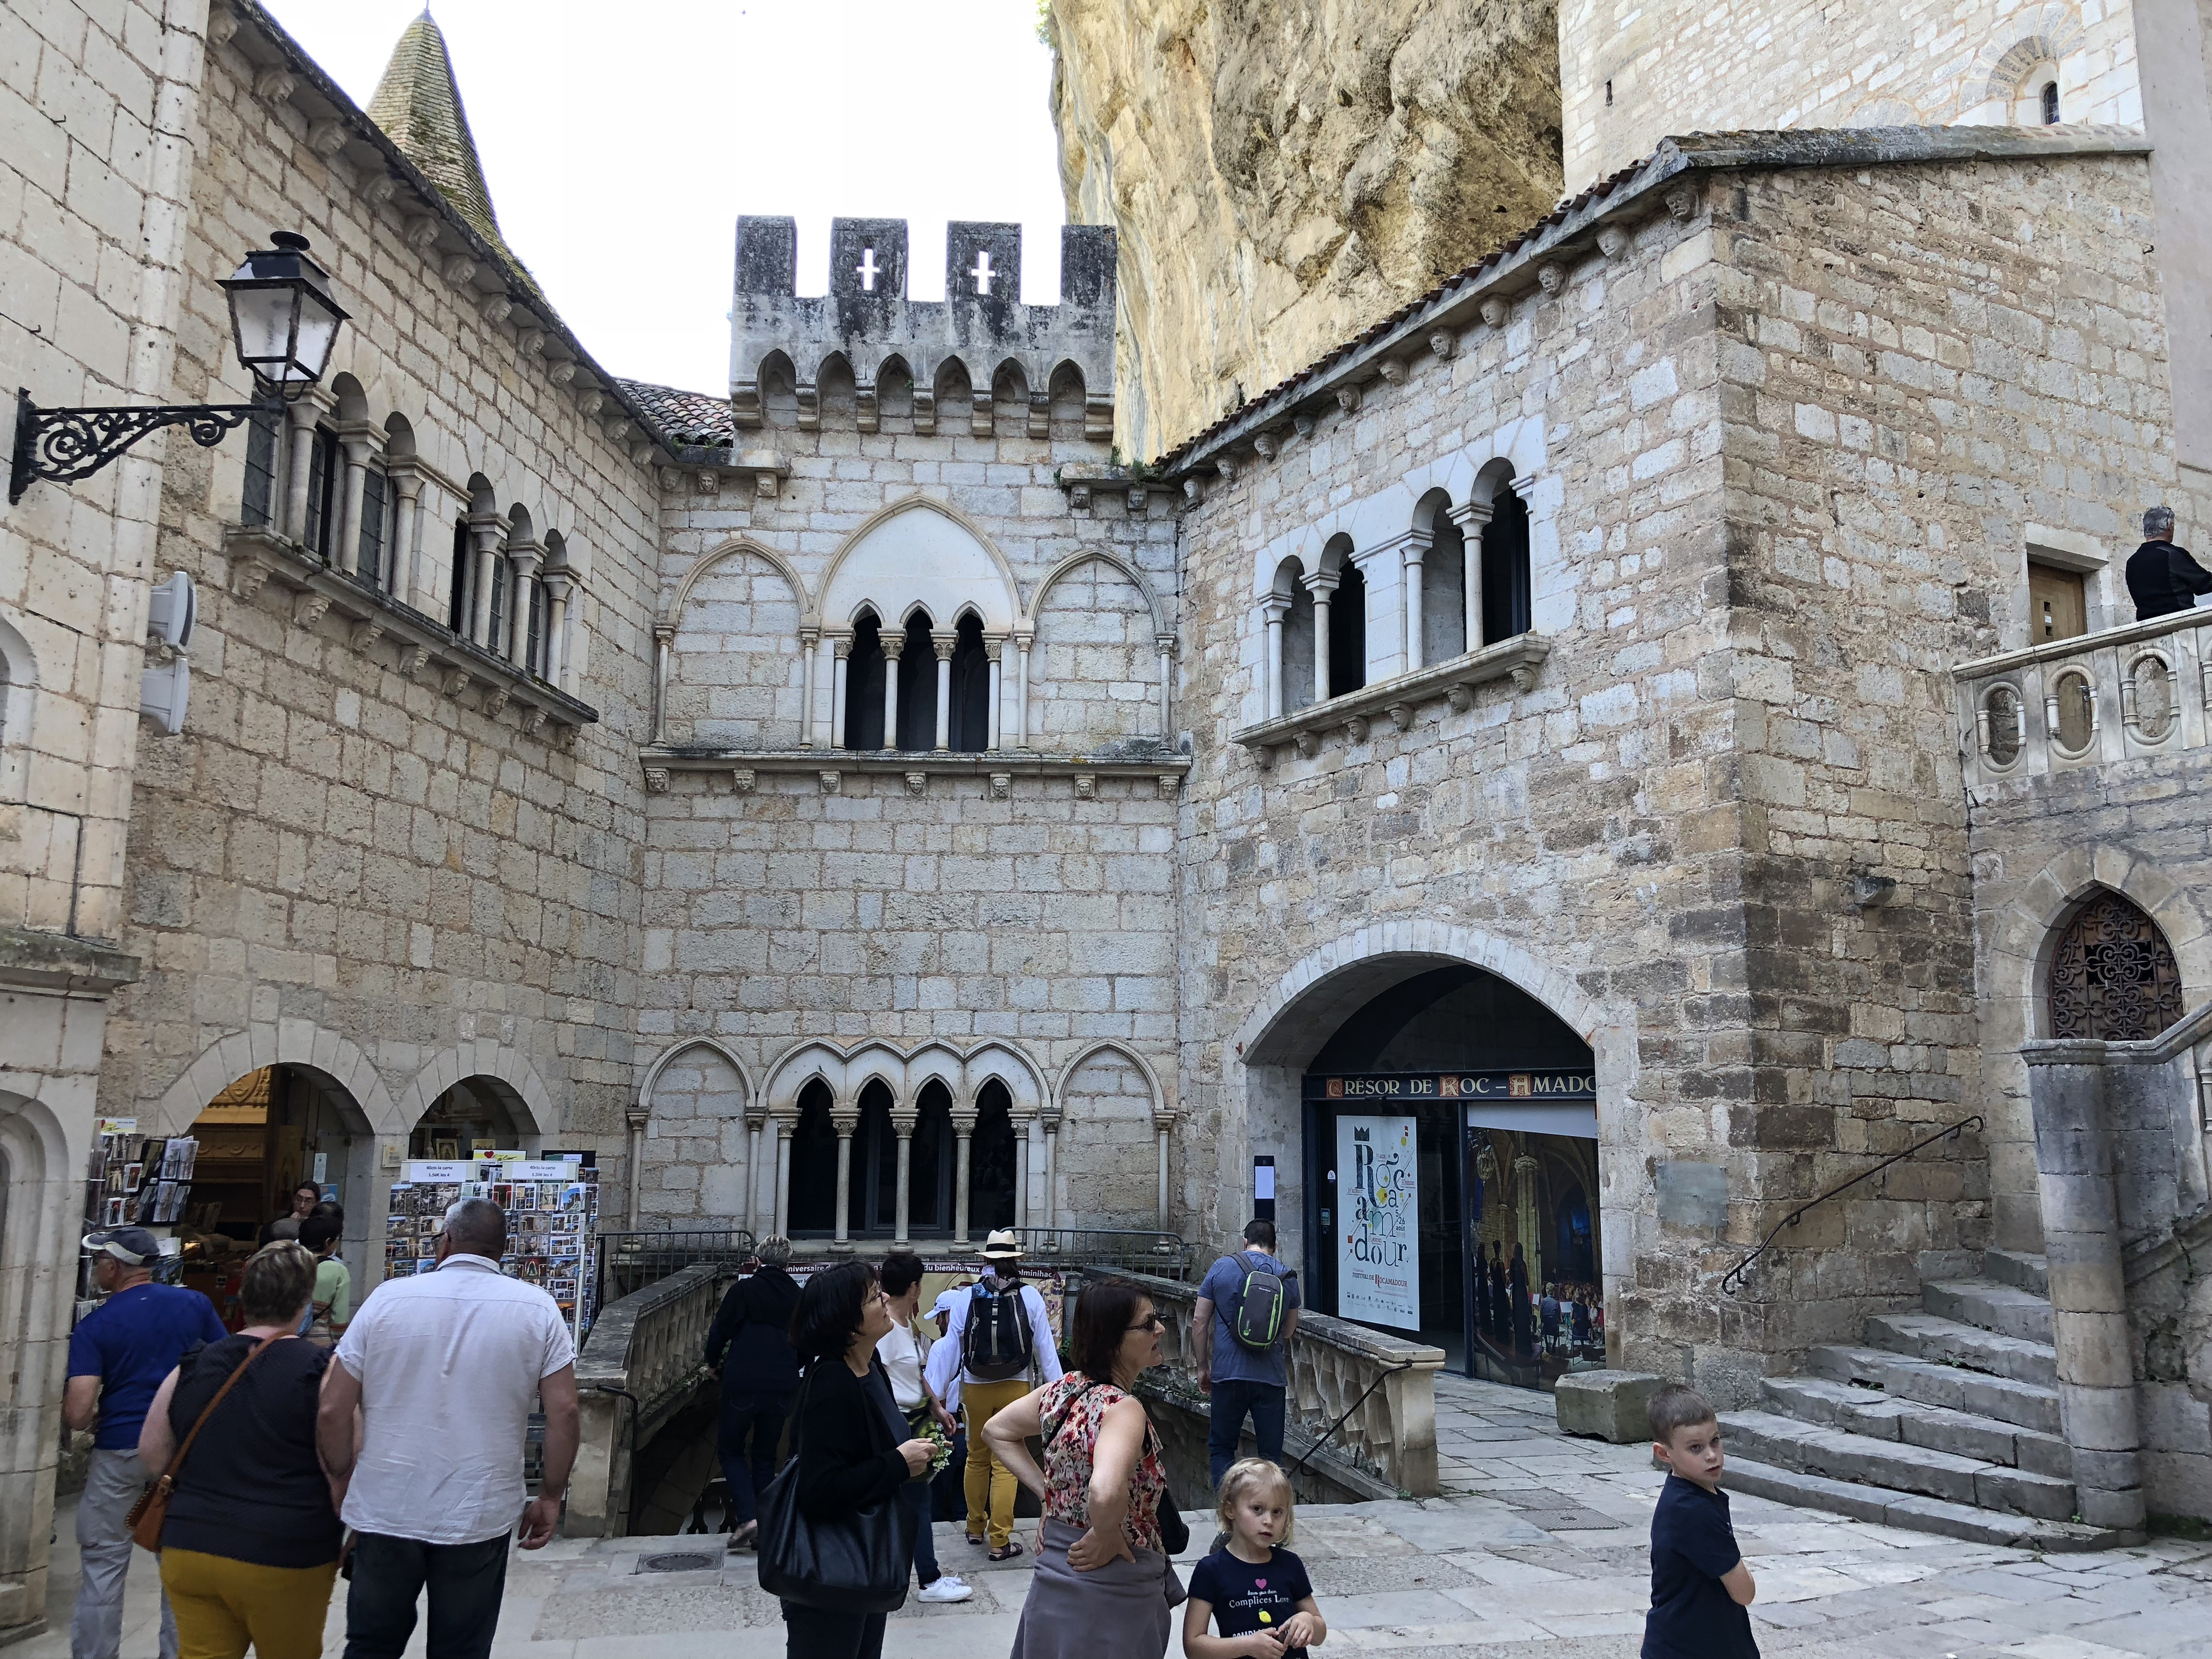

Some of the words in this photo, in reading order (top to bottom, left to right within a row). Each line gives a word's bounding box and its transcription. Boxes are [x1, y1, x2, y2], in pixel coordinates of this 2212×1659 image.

[1327, 1077, 1400, 1096] TRÉSOR
[1410, 1079, 1433, 1094] DE
[1440, 1076, 1490, 1096] ROC
[1375, 1274, 1408, 1288] ROCAMADOUR
[1229, 1595, 1272, 1608] Complices
